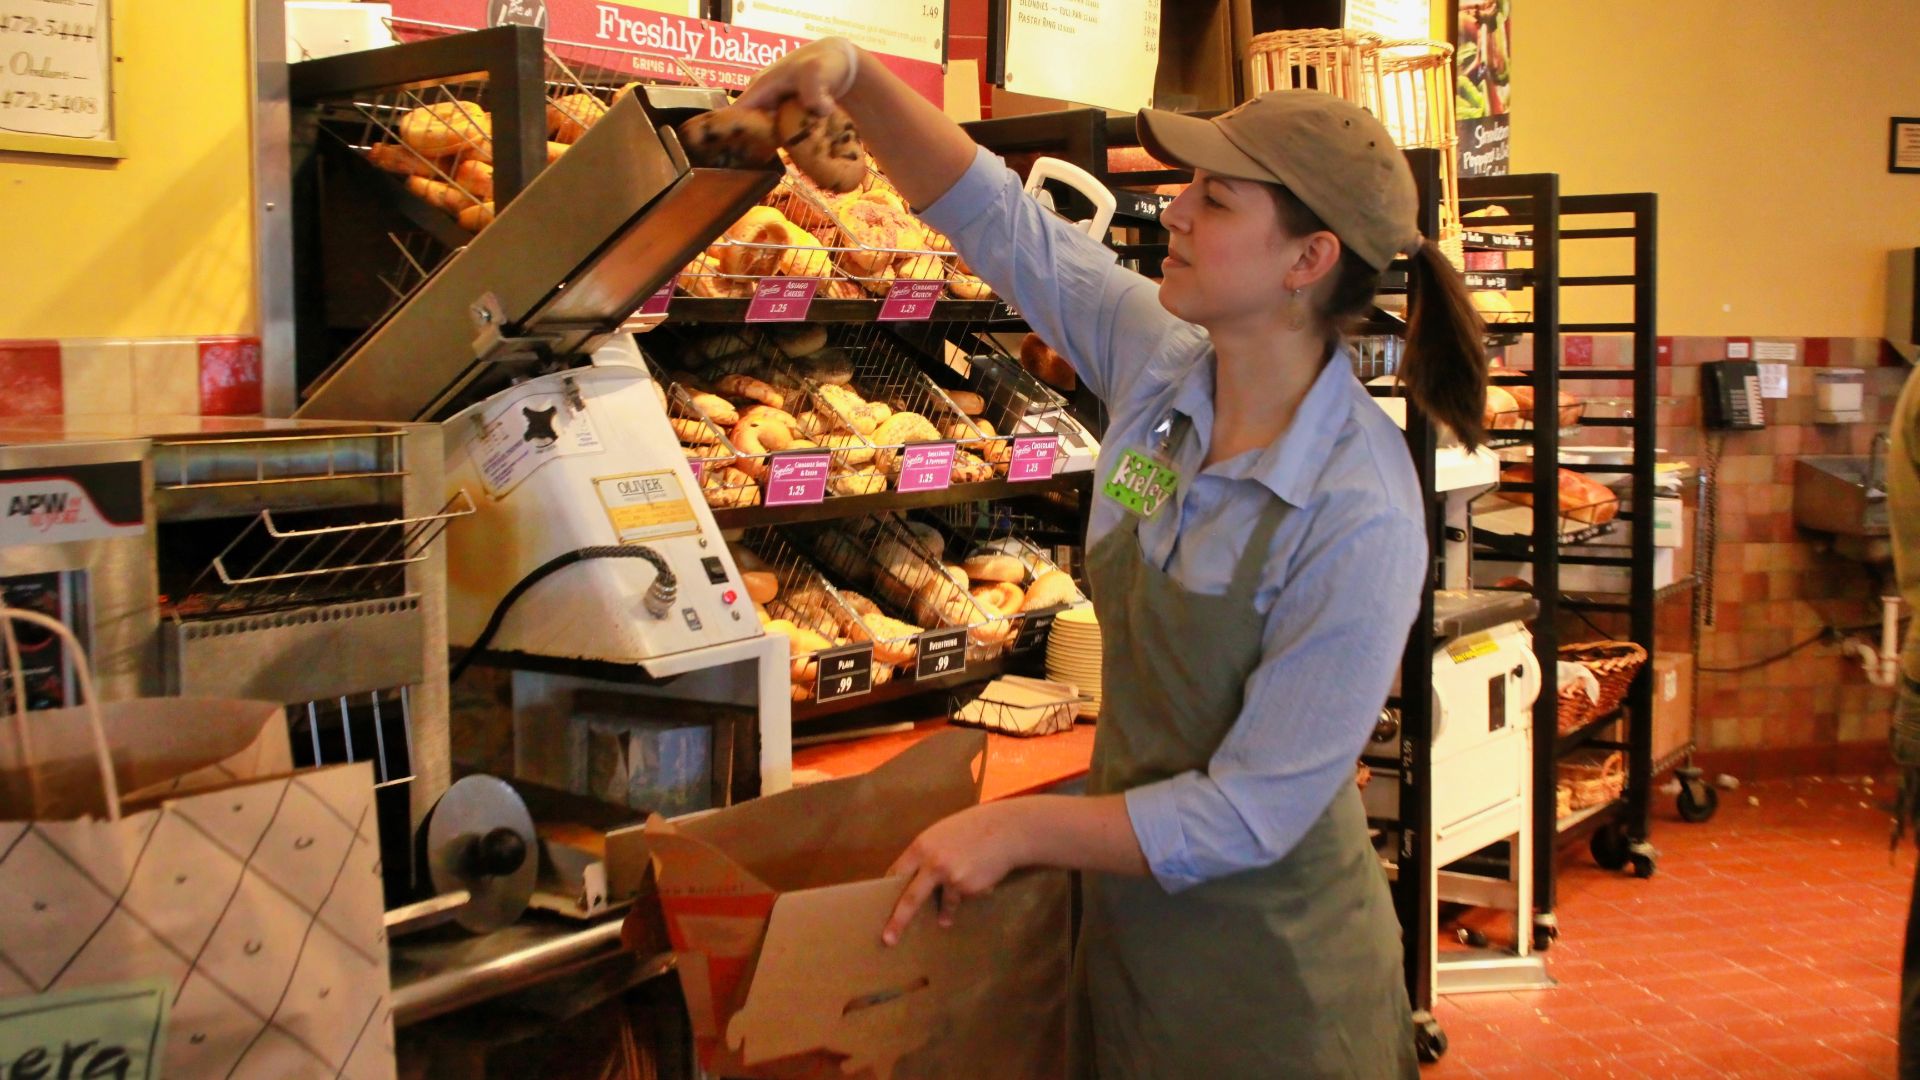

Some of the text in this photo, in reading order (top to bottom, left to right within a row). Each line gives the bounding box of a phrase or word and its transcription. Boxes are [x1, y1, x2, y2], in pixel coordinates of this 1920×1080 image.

[923, 5, 939, 20] 1.49
[1019, 11, 1041, 23] PASTRY
[1042, 17, 1057, 30] RING
[596, 4, 703, 61] Freshly
[708, 24, 788, 67] baked
[632, 57, 665, 73] BRING
[667, 62, 675, 75] A
[770, 303, 788, 313] 1.25
[900, 304, 917, 314] 1.25
[1026, 463, 1039, 473] 1.25
[919, 473, 934, 483] 1.25
[616, 478, 664, 495] OLIVER
[788, 484, 806, 497] 1.25
[6, 493, 69, 518] APW
[838, 658, 855, 672] PLAIN
[934, 655, 950, 672] .99
[835, 675, 852, 693] .99
